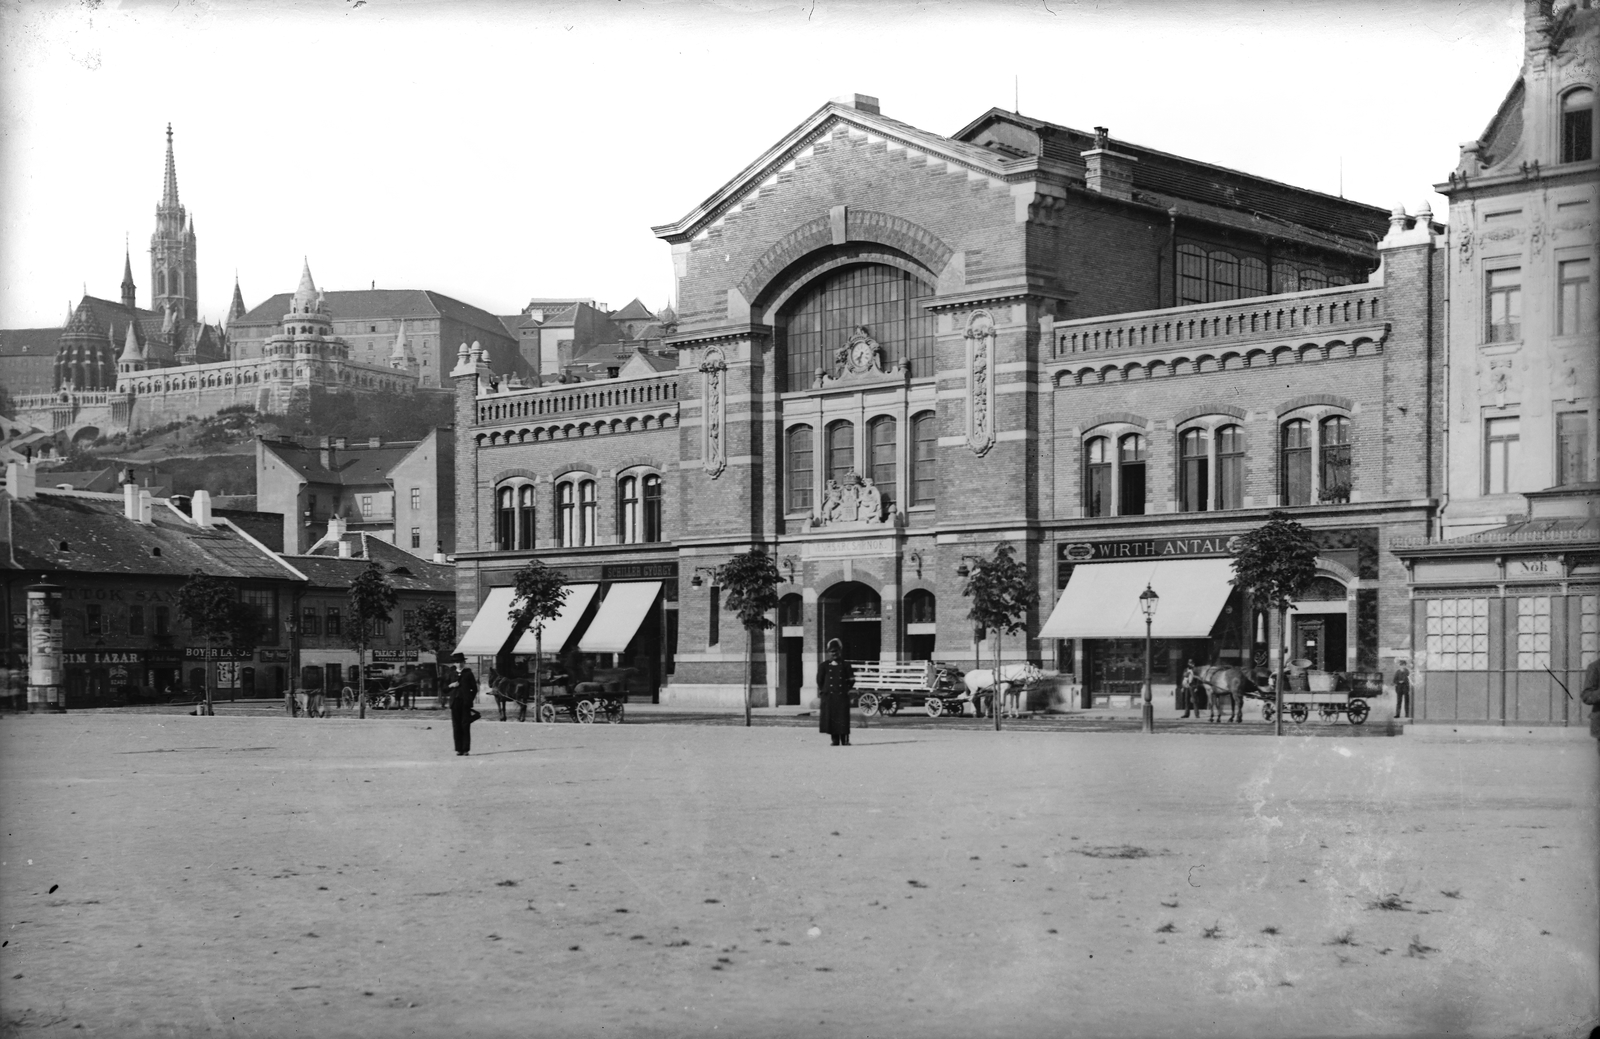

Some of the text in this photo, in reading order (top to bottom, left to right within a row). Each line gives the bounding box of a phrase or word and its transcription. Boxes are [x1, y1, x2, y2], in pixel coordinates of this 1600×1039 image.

[1098, 542, 1156, 557] WIRTH
[1162, 539, 1225, 555] ANTAL
[607, 566, 642, 578] SCHILLER
[185, 648, 218, 657] BOYR
